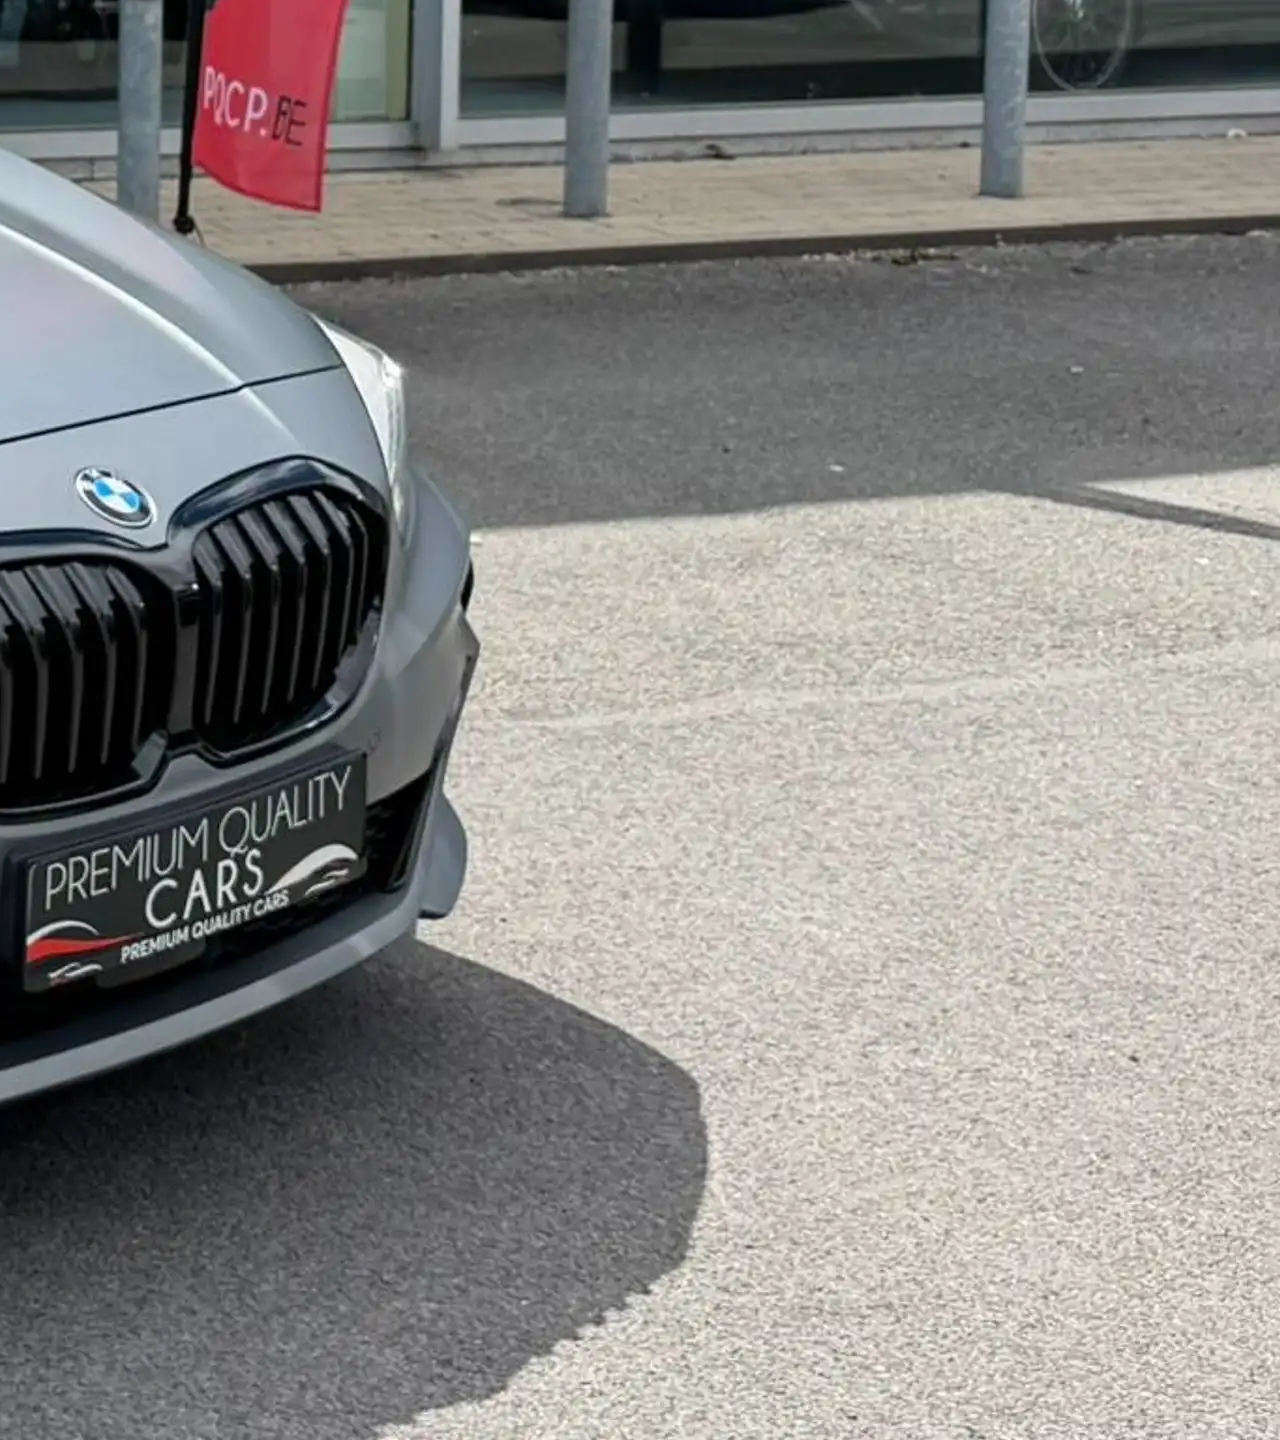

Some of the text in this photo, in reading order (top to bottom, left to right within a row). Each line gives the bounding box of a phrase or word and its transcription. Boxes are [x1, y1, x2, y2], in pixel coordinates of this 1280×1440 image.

[44, 764, 353, 911] PREMIUM QUALITY
[119, 888, 292, 964] PREMIUM QUALITY CARS
[144, 847, 265, 929] CARS
